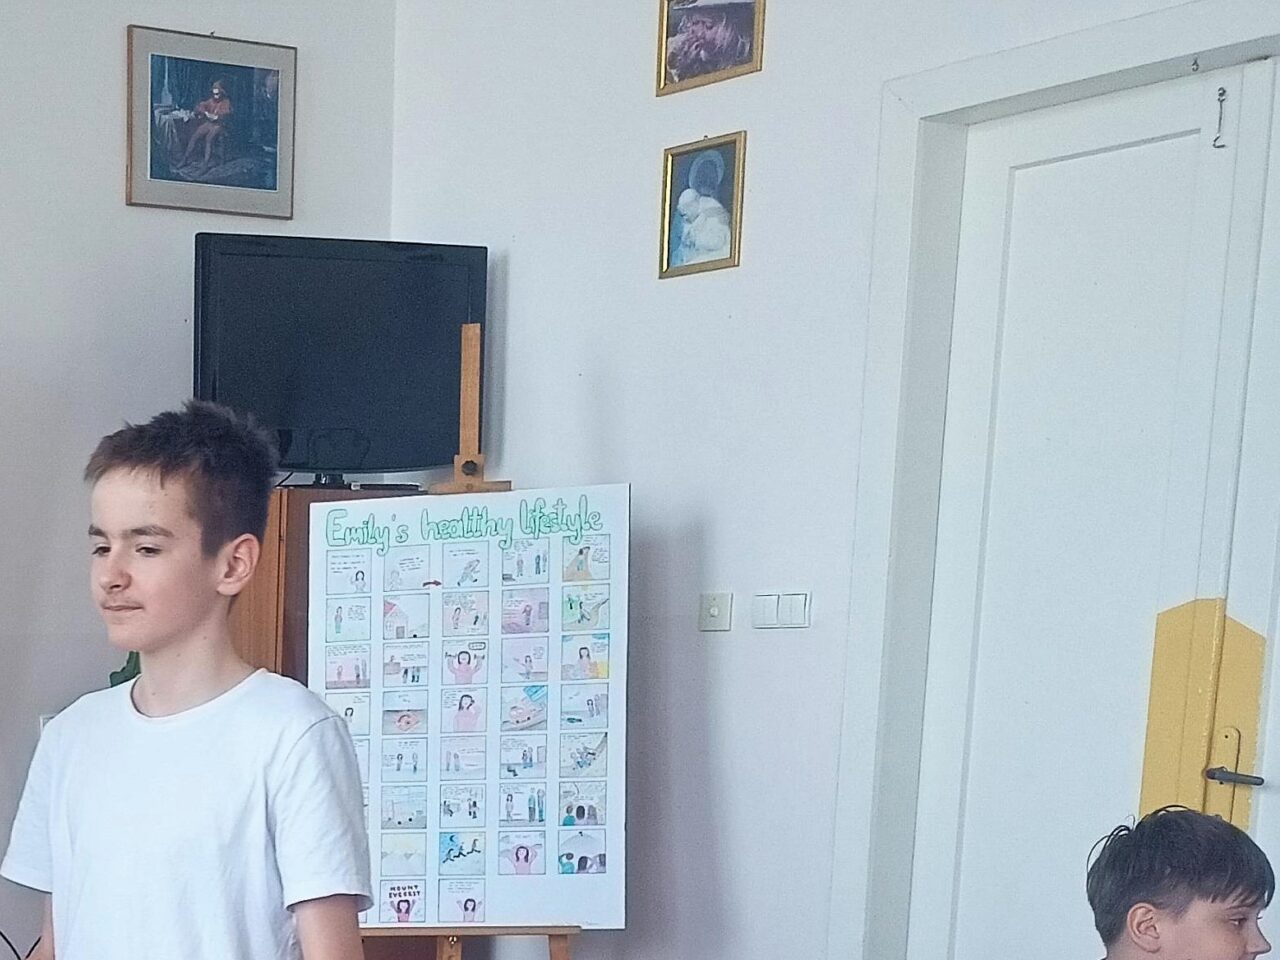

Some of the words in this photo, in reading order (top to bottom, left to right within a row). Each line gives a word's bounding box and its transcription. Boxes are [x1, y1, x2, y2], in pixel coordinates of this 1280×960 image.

[326, 508, 410, 557] Emily's
[420, 505, 514, 550] healthy
[519, 495, 603, 545] lifestyle
[389, 884, 419, 892] MOUNT
